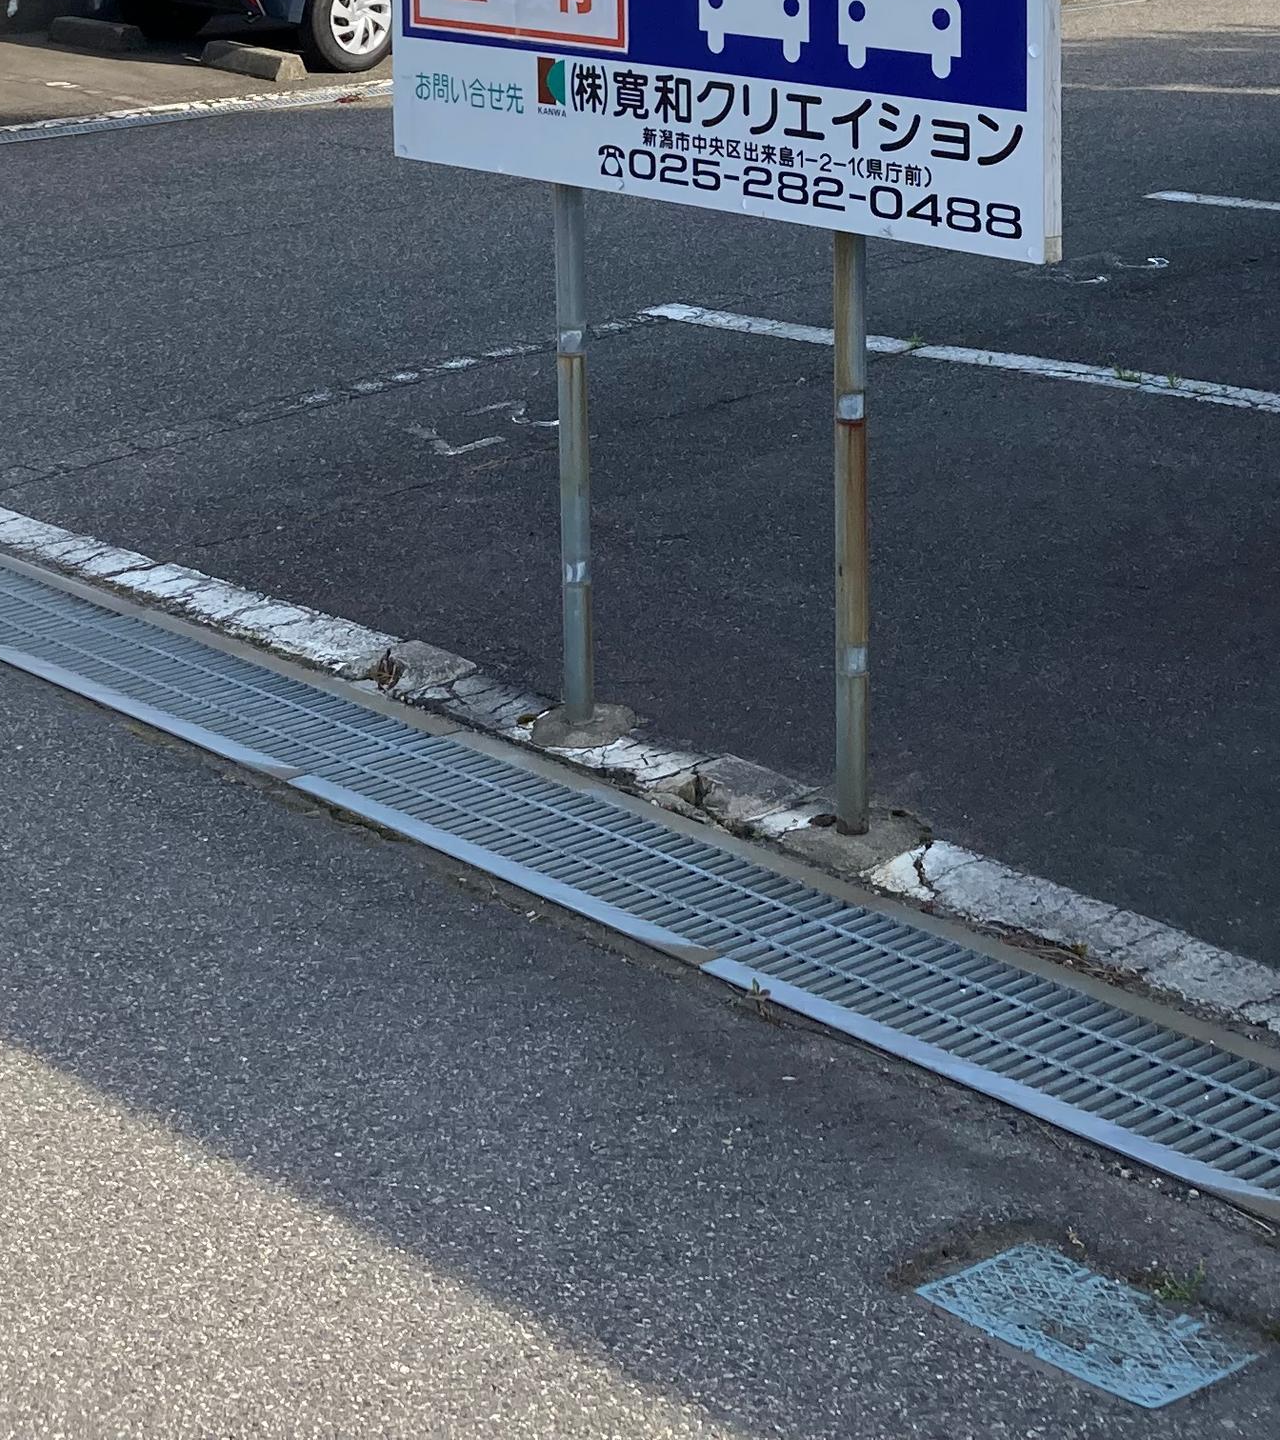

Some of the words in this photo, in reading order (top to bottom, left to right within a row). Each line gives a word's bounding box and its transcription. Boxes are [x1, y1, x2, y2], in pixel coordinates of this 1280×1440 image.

[415, 71, 525, 114] お問い合せ先
[537, 106, 567, 118] KANWA
[571, 62, 1025, 166] (株)寛和クリエイション
[628, 149, 1023, 240] 025-282-0488
